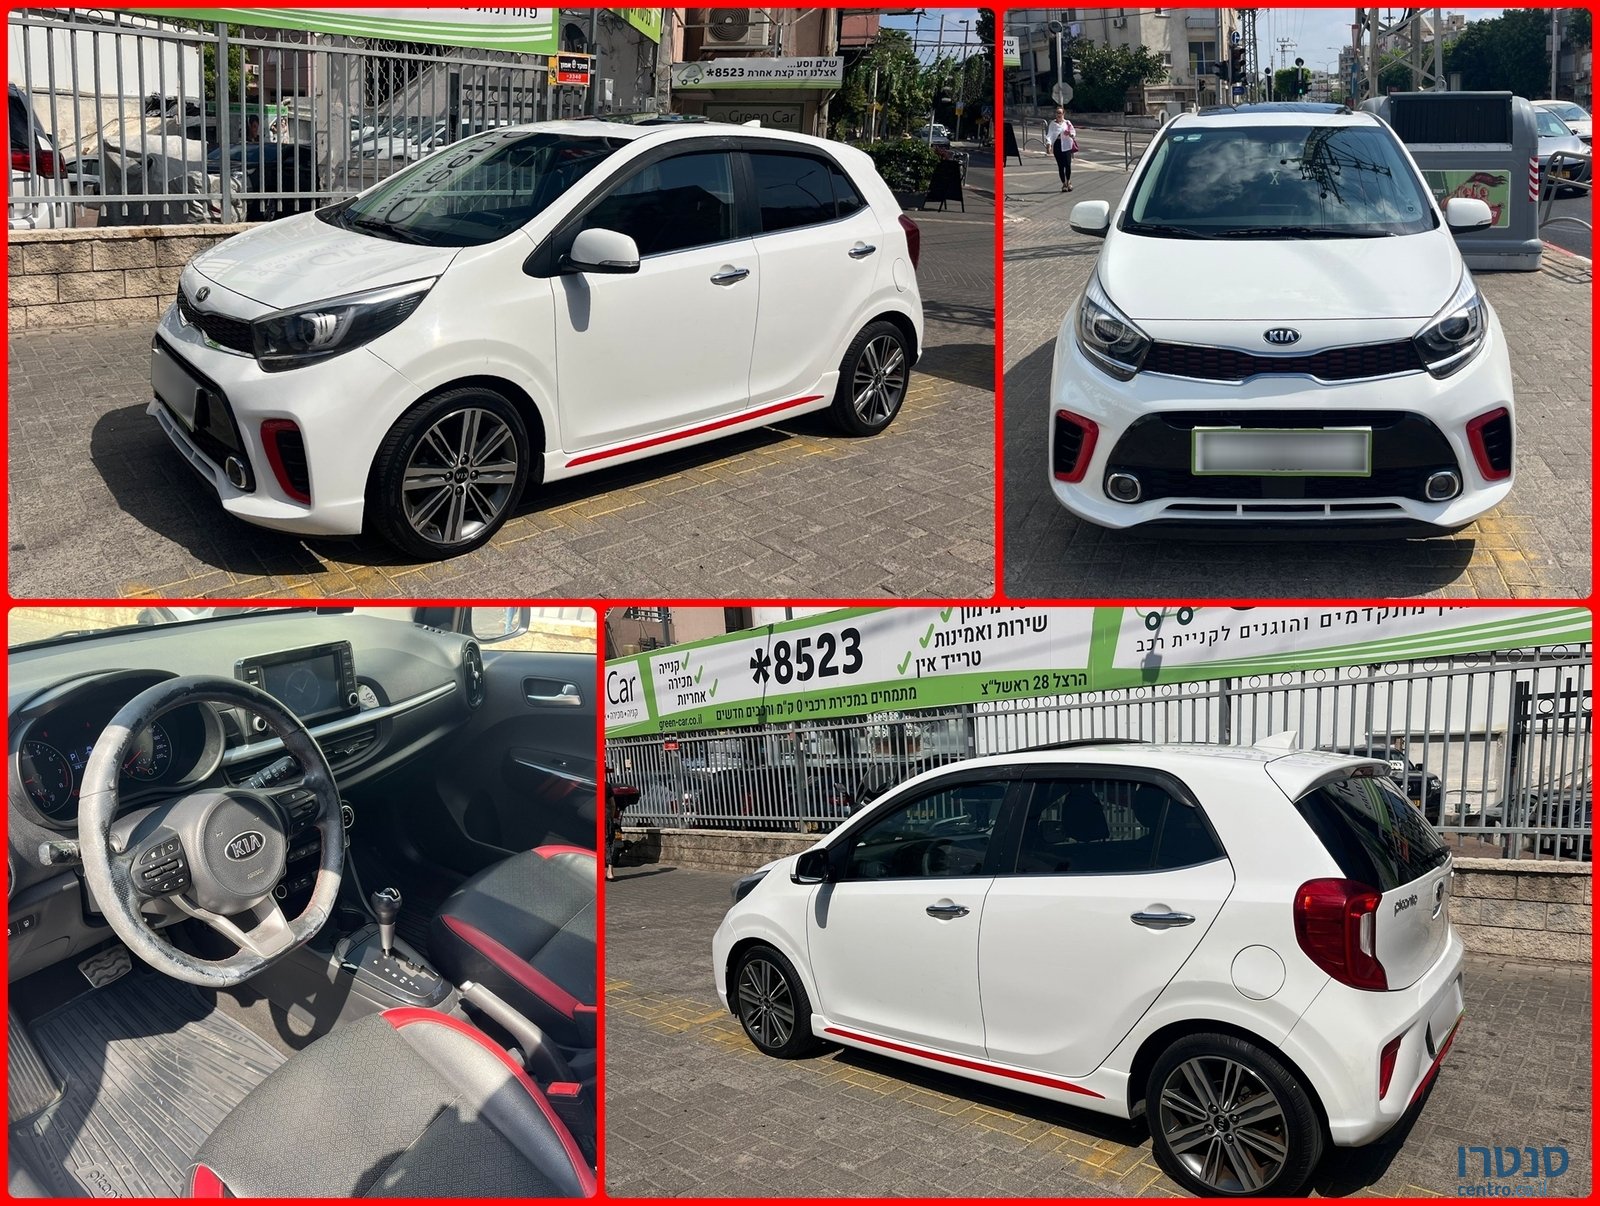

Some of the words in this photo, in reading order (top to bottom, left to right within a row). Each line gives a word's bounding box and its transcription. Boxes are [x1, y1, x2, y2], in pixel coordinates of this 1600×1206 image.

[815, 59, 838, 68] שלם
[747, 69, 772, 77] אחרת
[774, 69, 794, 79] קצת
[796, 69, 808, 77] זה
[810, 69, 837, 77] אצלנו
[728, 109, 769, 123] Green
[772, 110, 796, 123] Car
[1269, 330, 1295, 341] KIA
[997, 614, 1048, 639] שירות
[1240, 616, 1309, 639] והוגנים
[934, 624, 992, 648] ואמינות
[1171, 625, 1231, 648] לקניית
[1136, 637, 1165, 653] רכב
[659, 659, 680, 675] קנייה
[915, 656, 937, 678] אין
[941, 650, 982, 670] טרייד
[607, 670, 636, 705] Car
[668, 675, 693, 690] מכירה
[1033, 674, 1050, 690] 28
[1053, 671, 1088, 688] הרצל
[677, 690, 707, 706] אחריות
[829, 694, 868, 710] במכירת
[871, 687, 917, 704] מתמחים
[746, 704, 774, 719] ורכבים
[796, 699, 803, 713] 0
[805, 698, 826, 711] רכבי
[659, 713, 703, 730] green-car.co.il
[716, 706, 744, 721] חדשים
[230, 834, 261, 858] KIA
